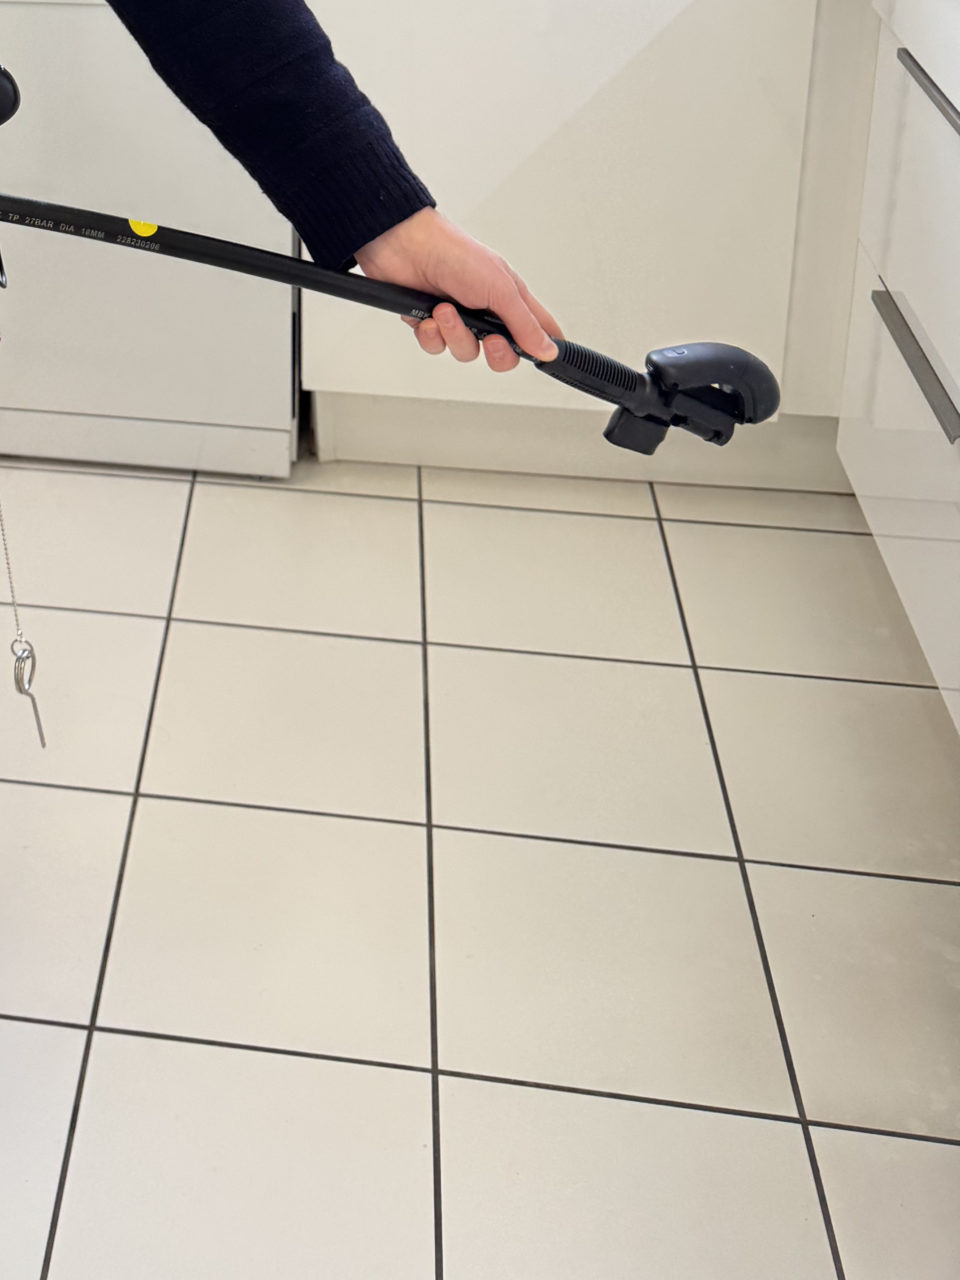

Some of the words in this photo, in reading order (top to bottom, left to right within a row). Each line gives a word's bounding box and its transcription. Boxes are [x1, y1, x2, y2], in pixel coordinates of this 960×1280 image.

[8, 213, 19, 221] TP
[24, 216, 54, 228] 27BAR
[59, 223, 75, 233] DIA
